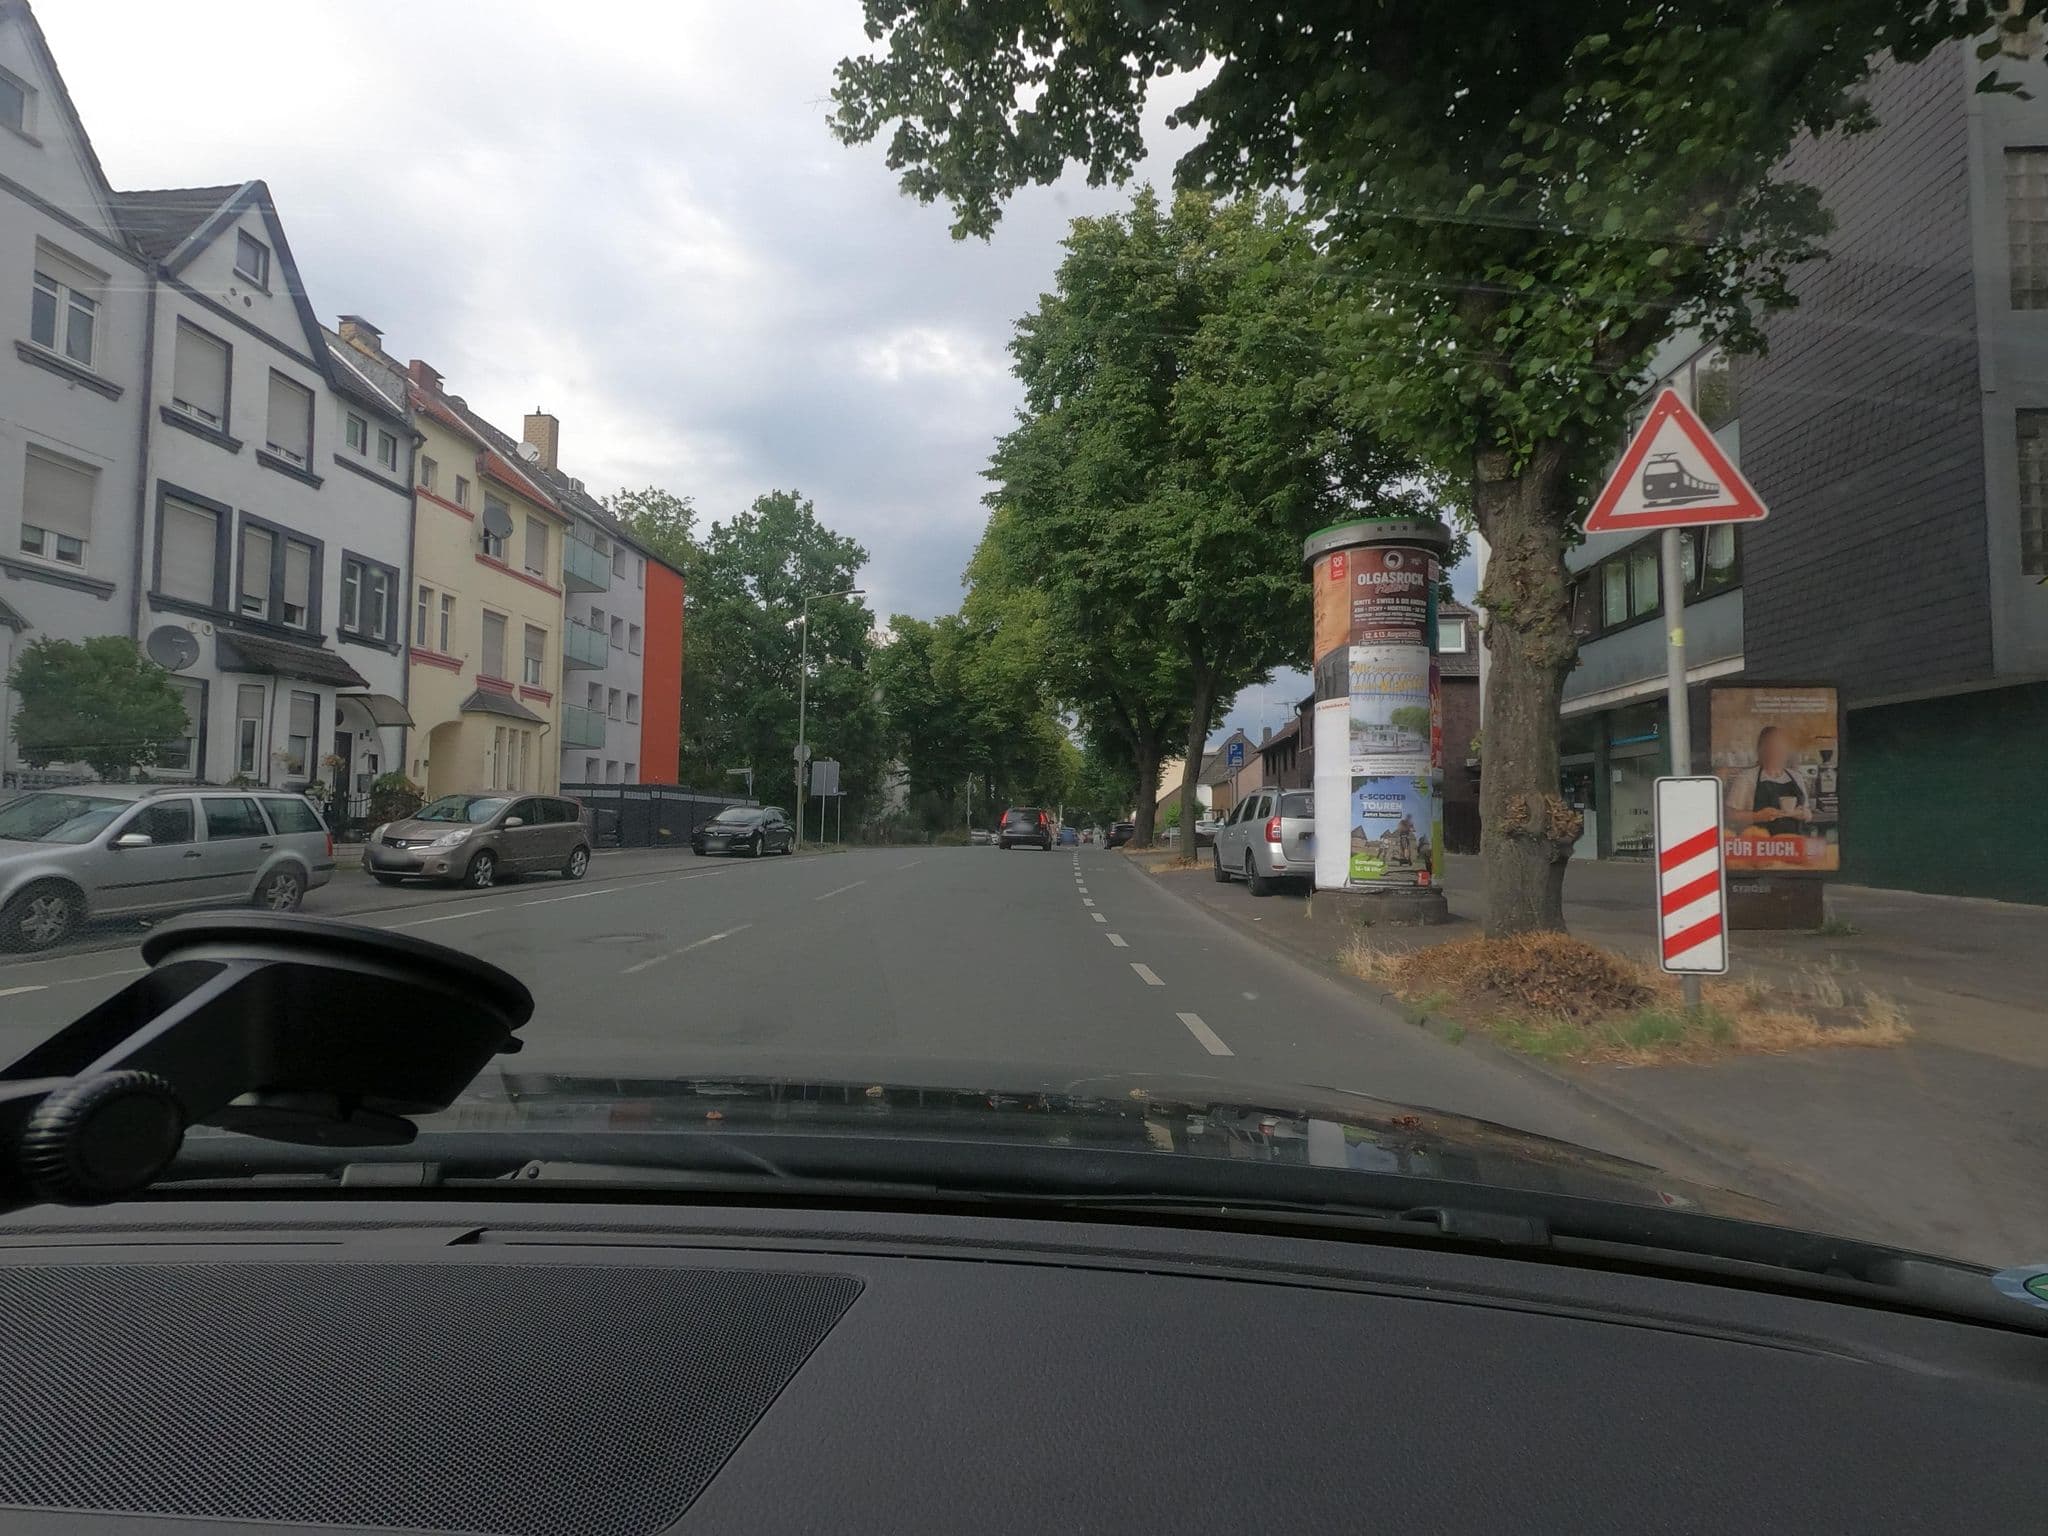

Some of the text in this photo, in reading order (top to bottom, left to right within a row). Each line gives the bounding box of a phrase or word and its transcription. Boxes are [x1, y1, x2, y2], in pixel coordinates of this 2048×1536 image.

[1358, 572, 1424, 586] OLGASROCK
[1362, 801, 1402, 810] TOUREN
[1725, 838, 1799, 857] FÜR EUCH.
